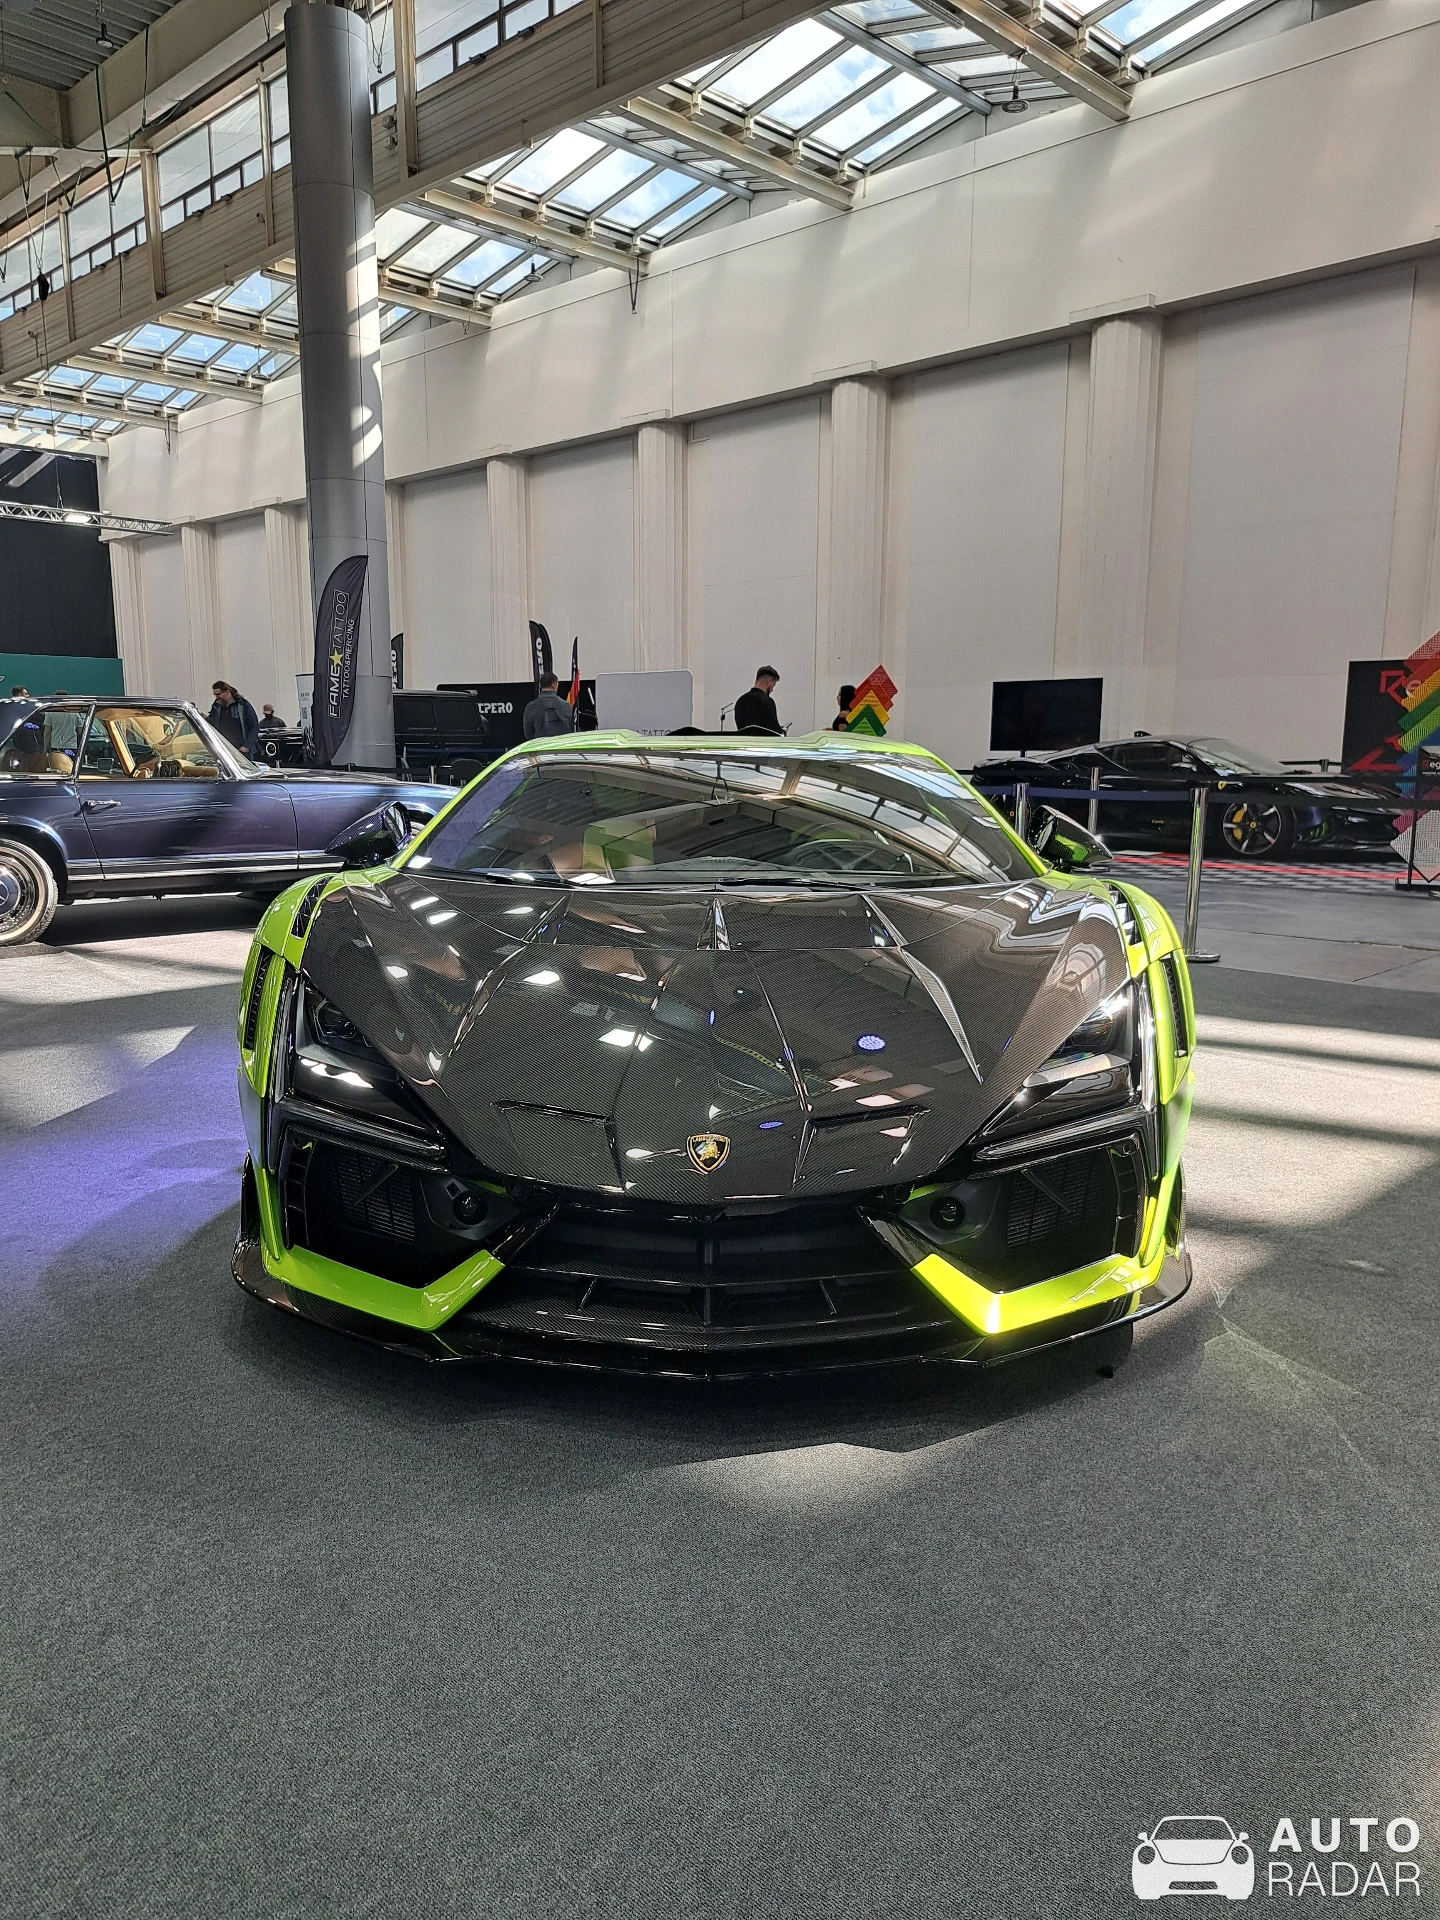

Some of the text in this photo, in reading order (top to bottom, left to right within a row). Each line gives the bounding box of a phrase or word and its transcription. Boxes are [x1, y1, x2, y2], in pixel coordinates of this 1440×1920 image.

[329, 592, 347, 718] FAME TATTOO
[342, 618, 355, 699] TATTOO&PIERCING
